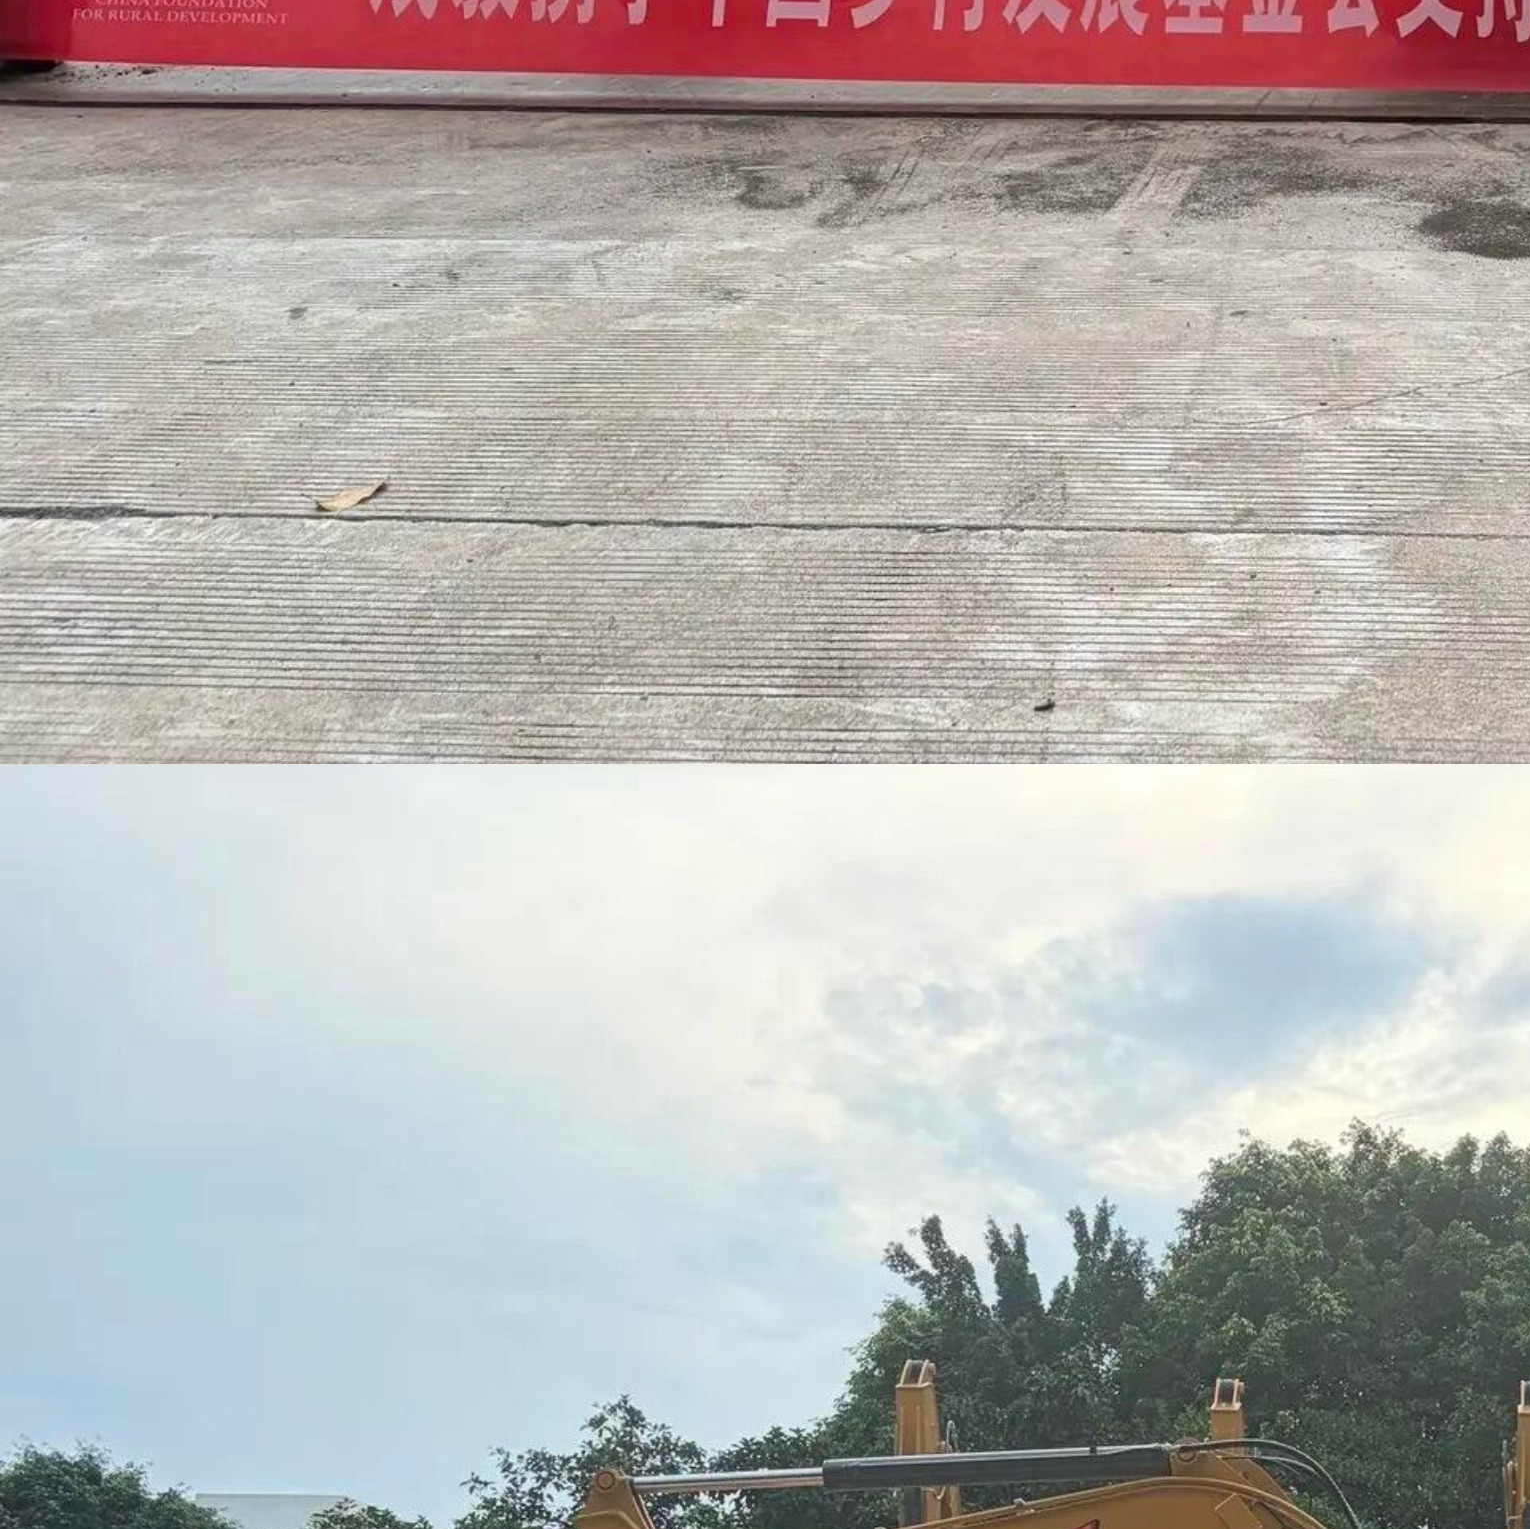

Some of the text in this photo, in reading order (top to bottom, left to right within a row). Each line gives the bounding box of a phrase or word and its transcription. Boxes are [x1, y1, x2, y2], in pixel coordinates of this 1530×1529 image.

[72, 9, 289, 25] FOR RURAL DEVELOPMENT
